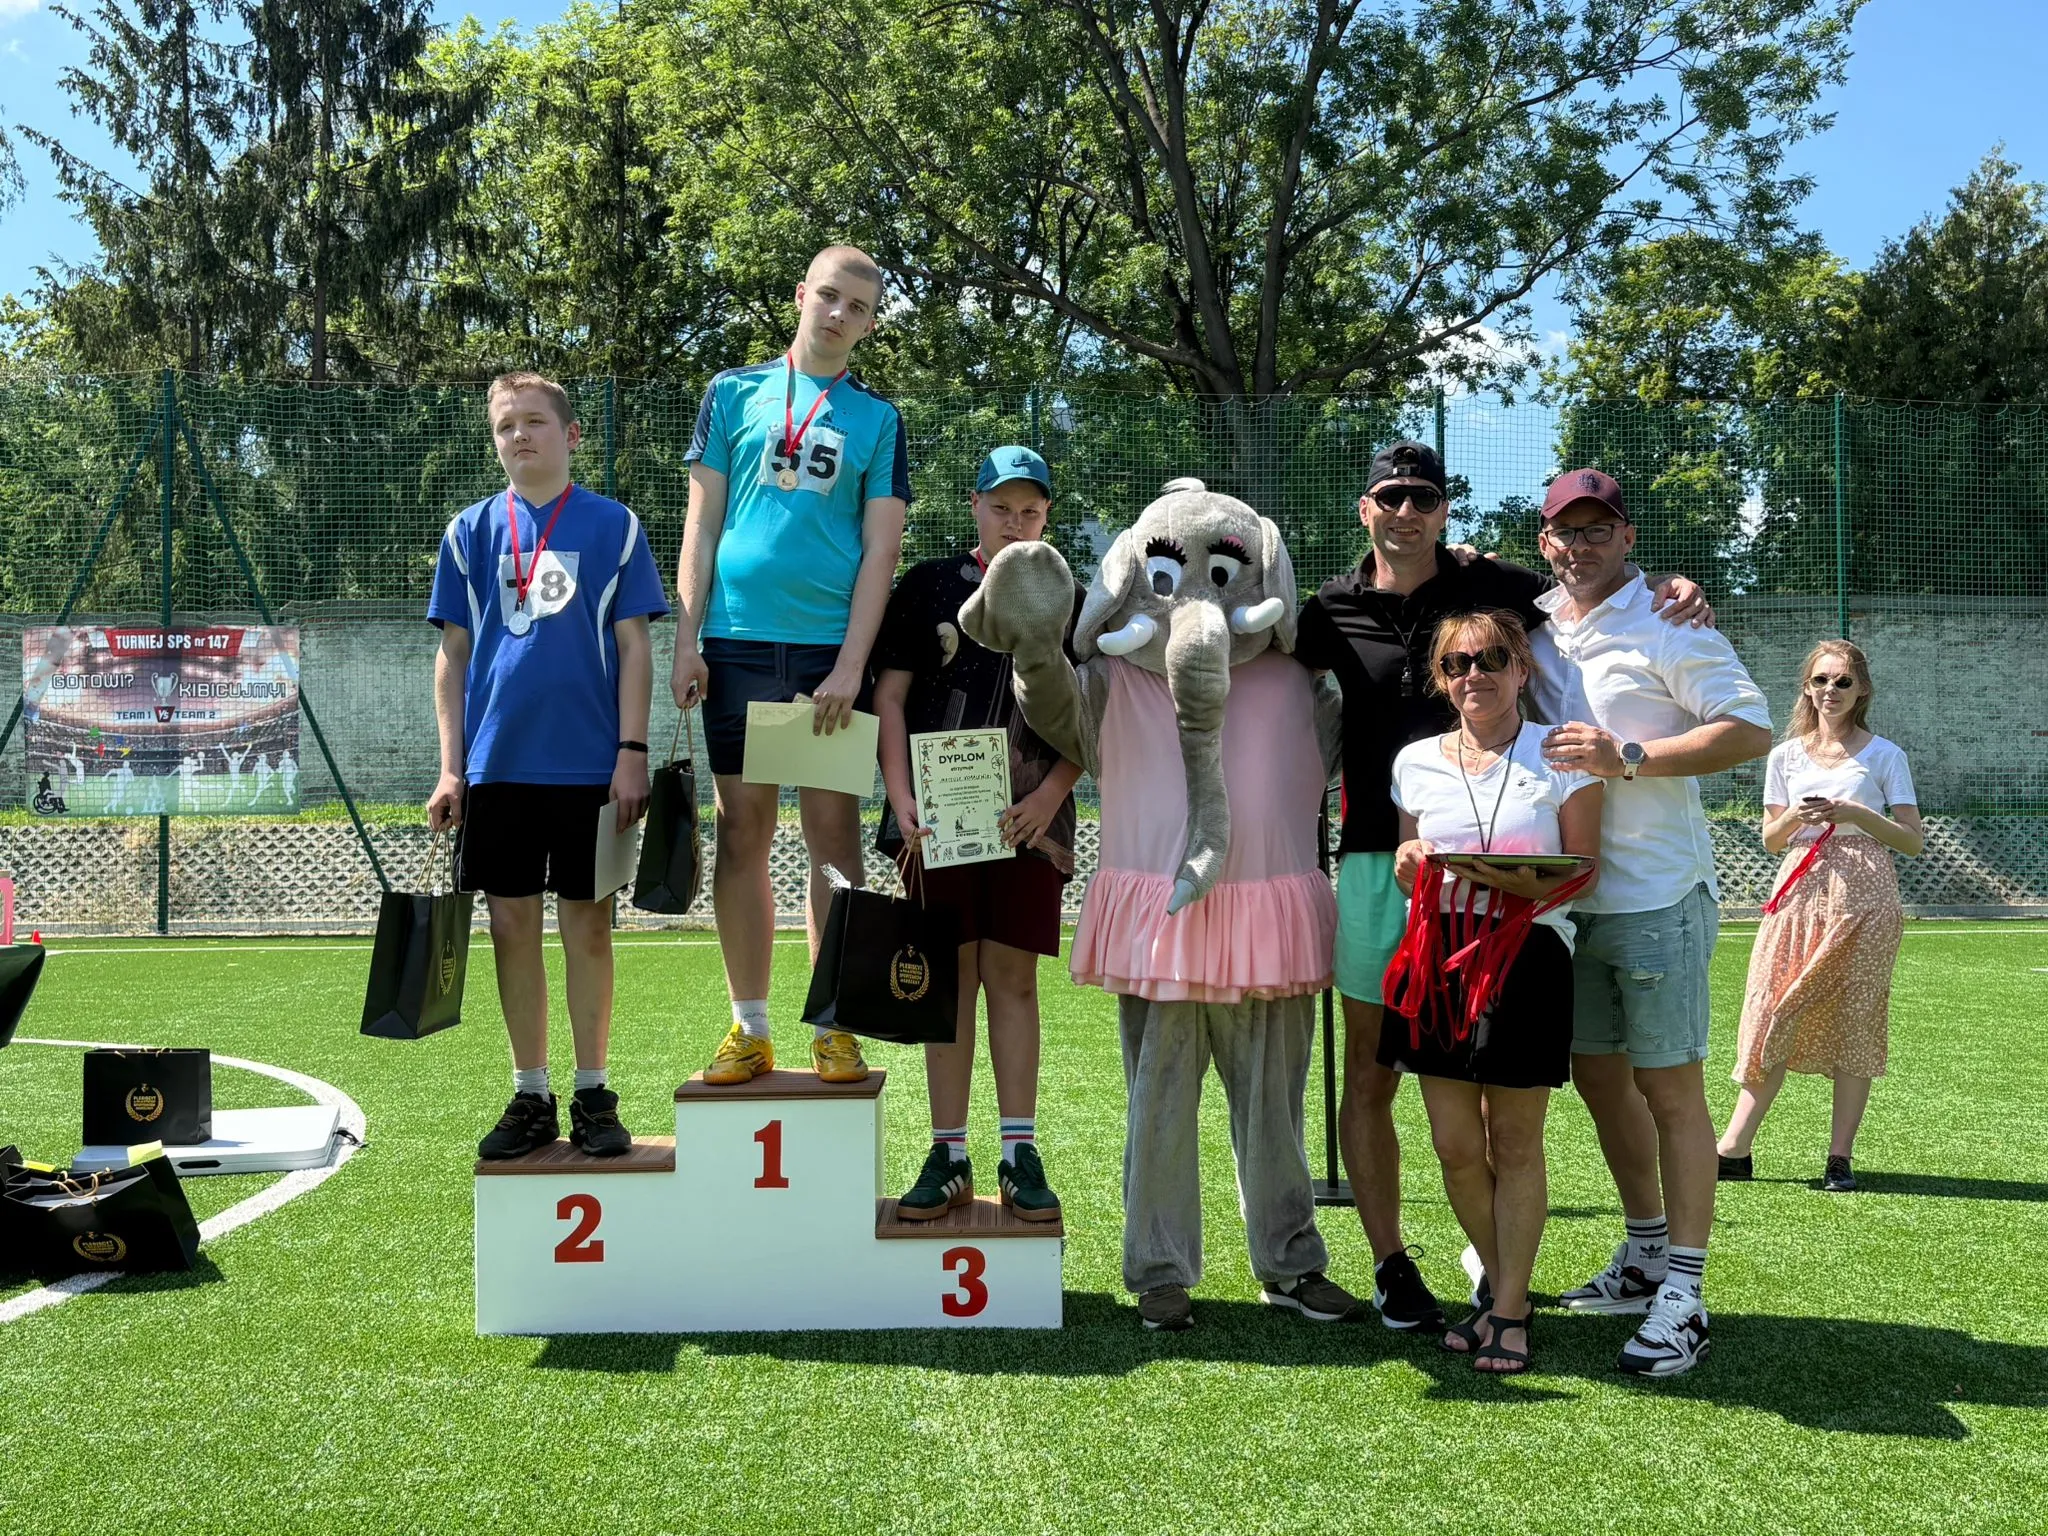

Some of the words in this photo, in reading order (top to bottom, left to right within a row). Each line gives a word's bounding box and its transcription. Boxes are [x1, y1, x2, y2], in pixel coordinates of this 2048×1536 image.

[771, 439, 838, 479] 55
[115, 634, 164, 650] TURNIEJ
[167, 634, 192, 649] SPS
[194, 637, 205, 647] nr
[207, 634, 230, 649] 147
[52, 673, 135, 690] GOTOWI?
[178, 681, 287, 699] KIBICUJMY!
[116, 711, 145, 719] TEAM
[147, 711, 151, 719] 1
[175, 710, 207, 719] TEAM
[209, 710, 216, 719] 2
[938, 752, 985, 764] DYPLOM
[754, 1119, 789, 1189] 1
[554, 1193, 604, 1263] 2
[941, 1246, 988, 1317] 3
